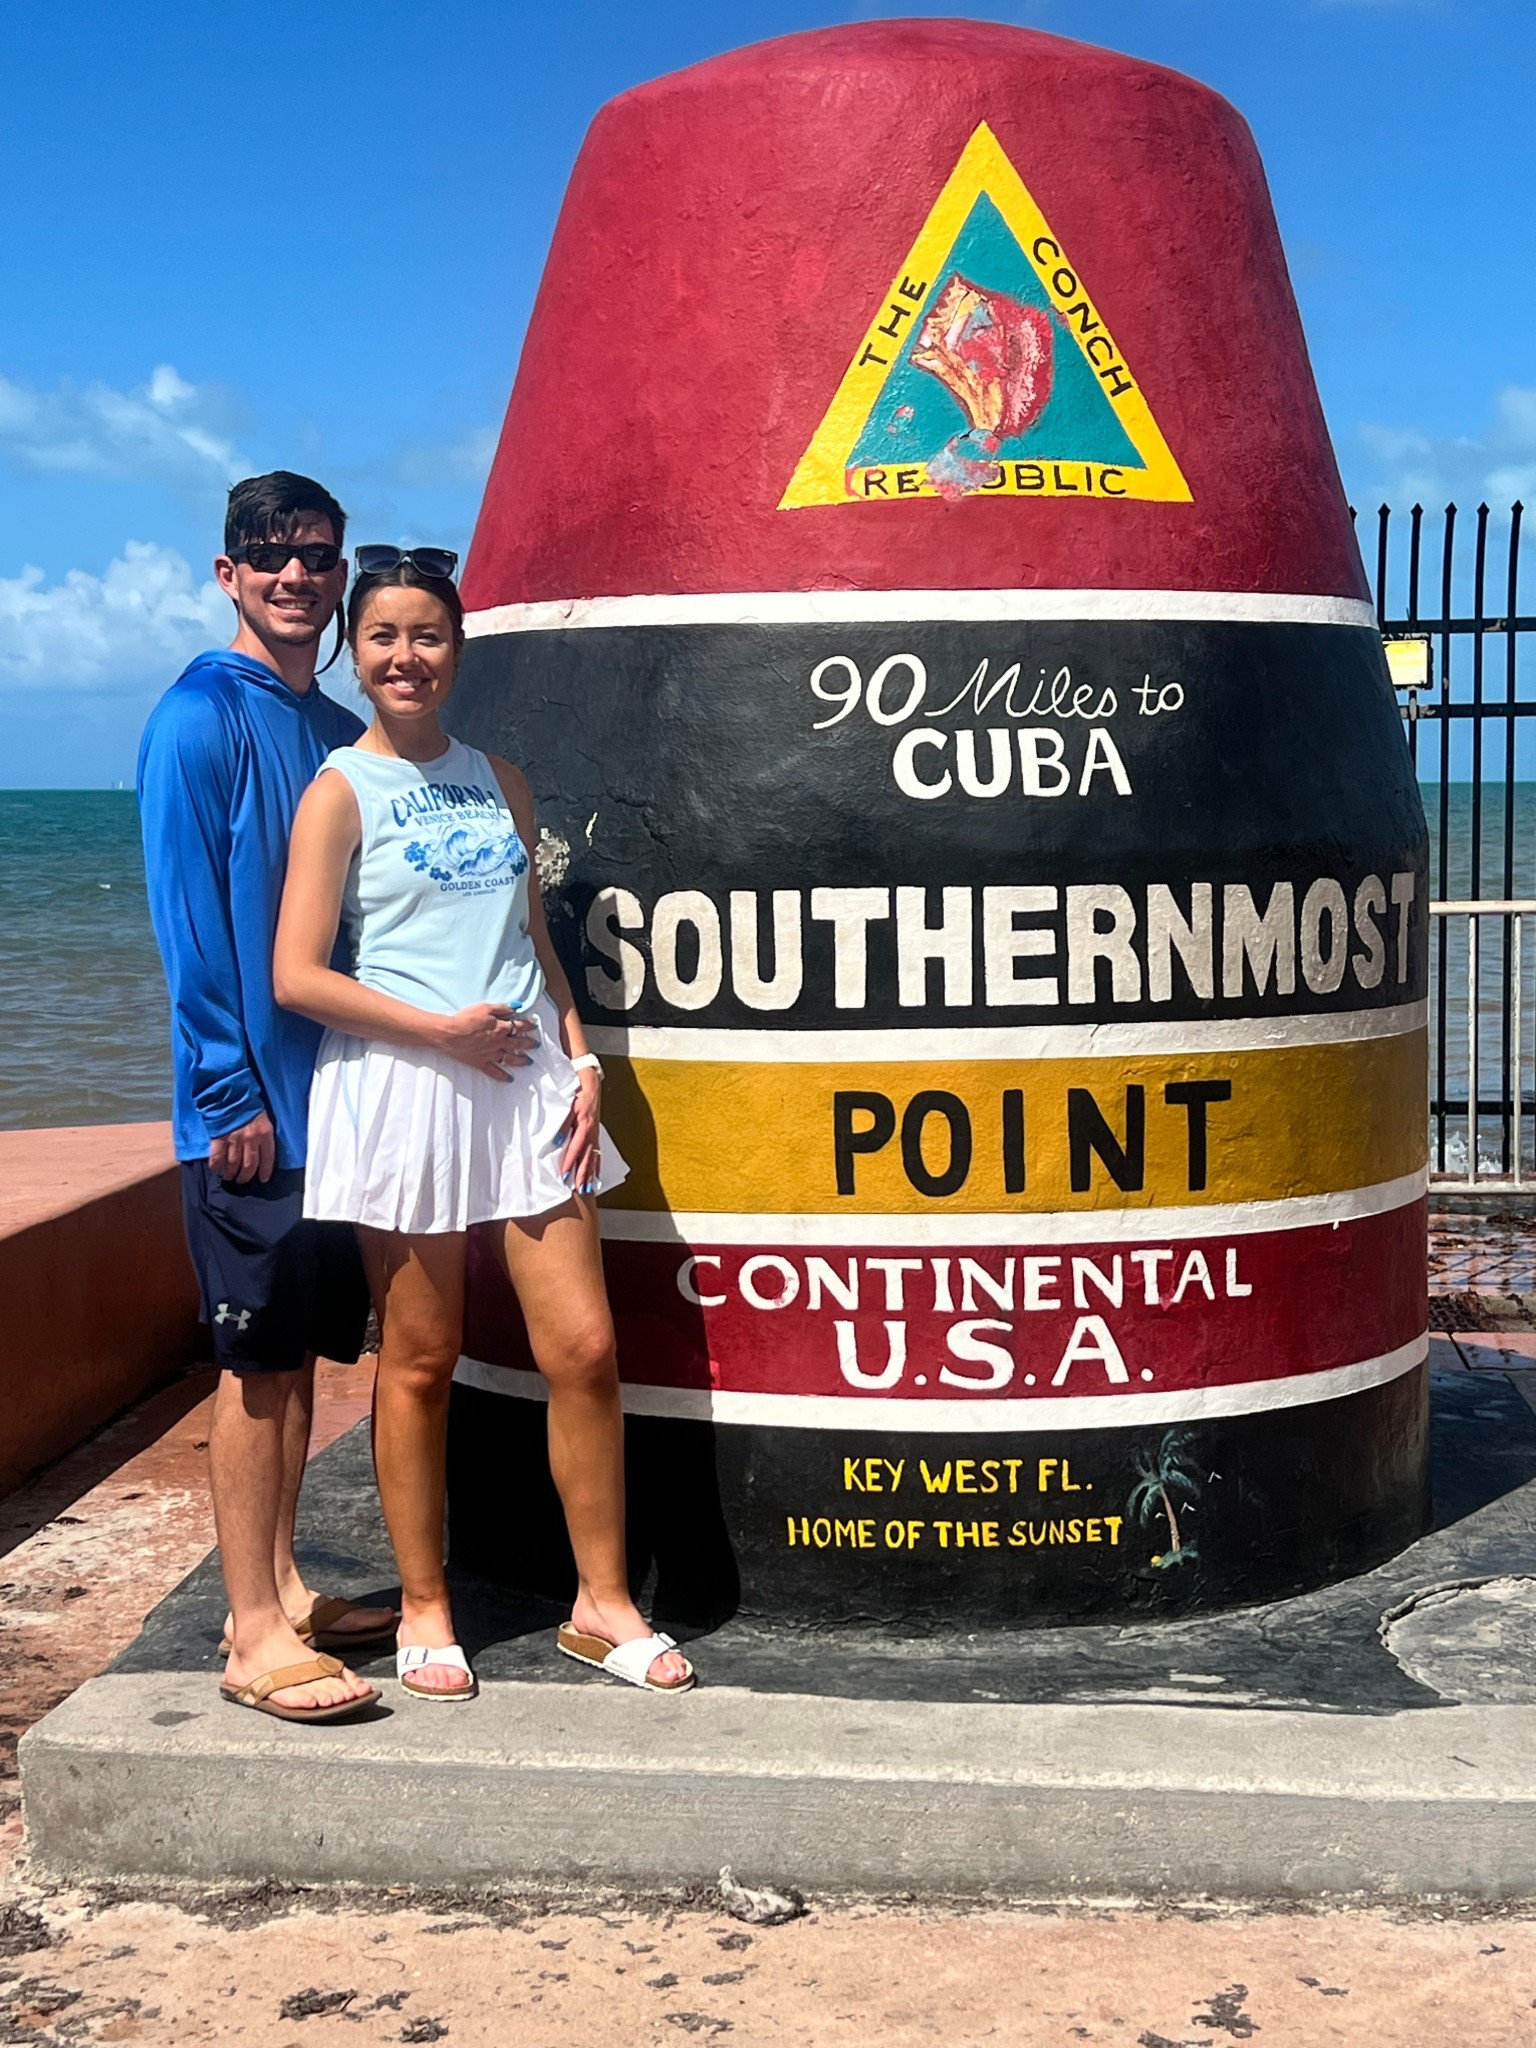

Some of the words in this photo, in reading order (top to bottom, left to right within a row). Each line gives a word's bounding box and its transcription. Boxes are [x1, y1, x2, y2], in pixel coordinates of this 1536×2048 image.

[859, 276, 926, 367] THE
[1033, 237, 1132, 396] CONCH
[864, 464, 1126, 496] REUBLIC
[810, 653, 927, 730] 90
[924, 658, 1118, 719] Miles
[1131, 674, 1184, 715] to
[893, 727, 1133, 800] CUBA
[414, 812, 455, 826] VENICE
[456, 809, 498, 821] BEACH
[440, 880, 481, 891] GOLDEN
[484, 876, 515, 887] COAST
[585, 872, 1415, 1011] SOUTHERNMOST
[834, 1080, 1231, 1197] POINT
[676, 1247, 1253, 1312] CONTINENTAL
[833, 1315, 1154, 1390] U.S.A.
[843, 1457, 905, 1492] KEY
[920, 1457, 1022, 1494] WEST
[1038, 1457, 1094, 1492] FL.
[787, 1516, 876, 1547] HOME
[884, 1519, 925, 1549] OF
[933, 1520, 999, 1548] THE
[1008, 1516, 1123, 1546] SUNSET
